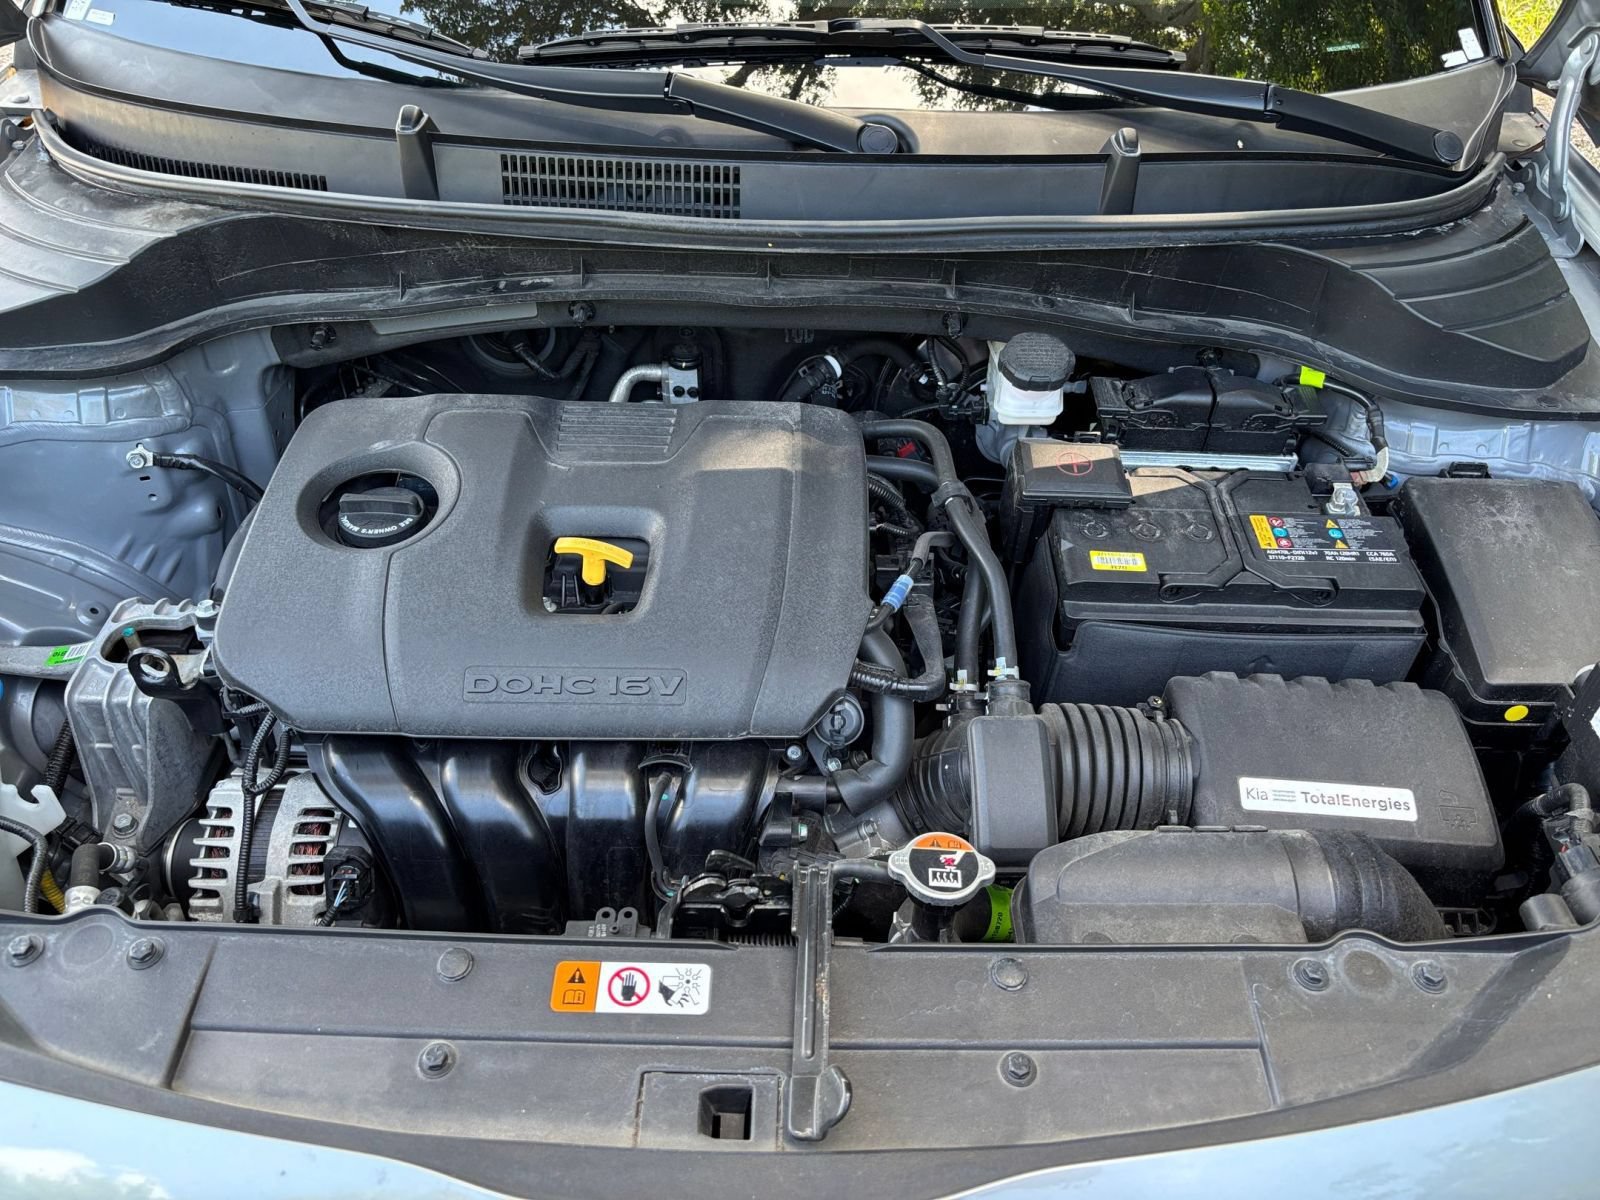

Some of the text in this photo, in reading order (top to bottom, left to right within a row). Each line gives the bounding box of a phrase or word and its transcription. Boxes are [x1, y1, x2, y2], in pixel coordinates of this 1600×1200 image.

[341, 515, 414, 535] SEE OWNER'S MANUAL
[466, 673, 684, 697] DOHC 16V
[1246, 787, 1269, 801] Kia
[1301, 791, 1411, 812] TotalEnergies
